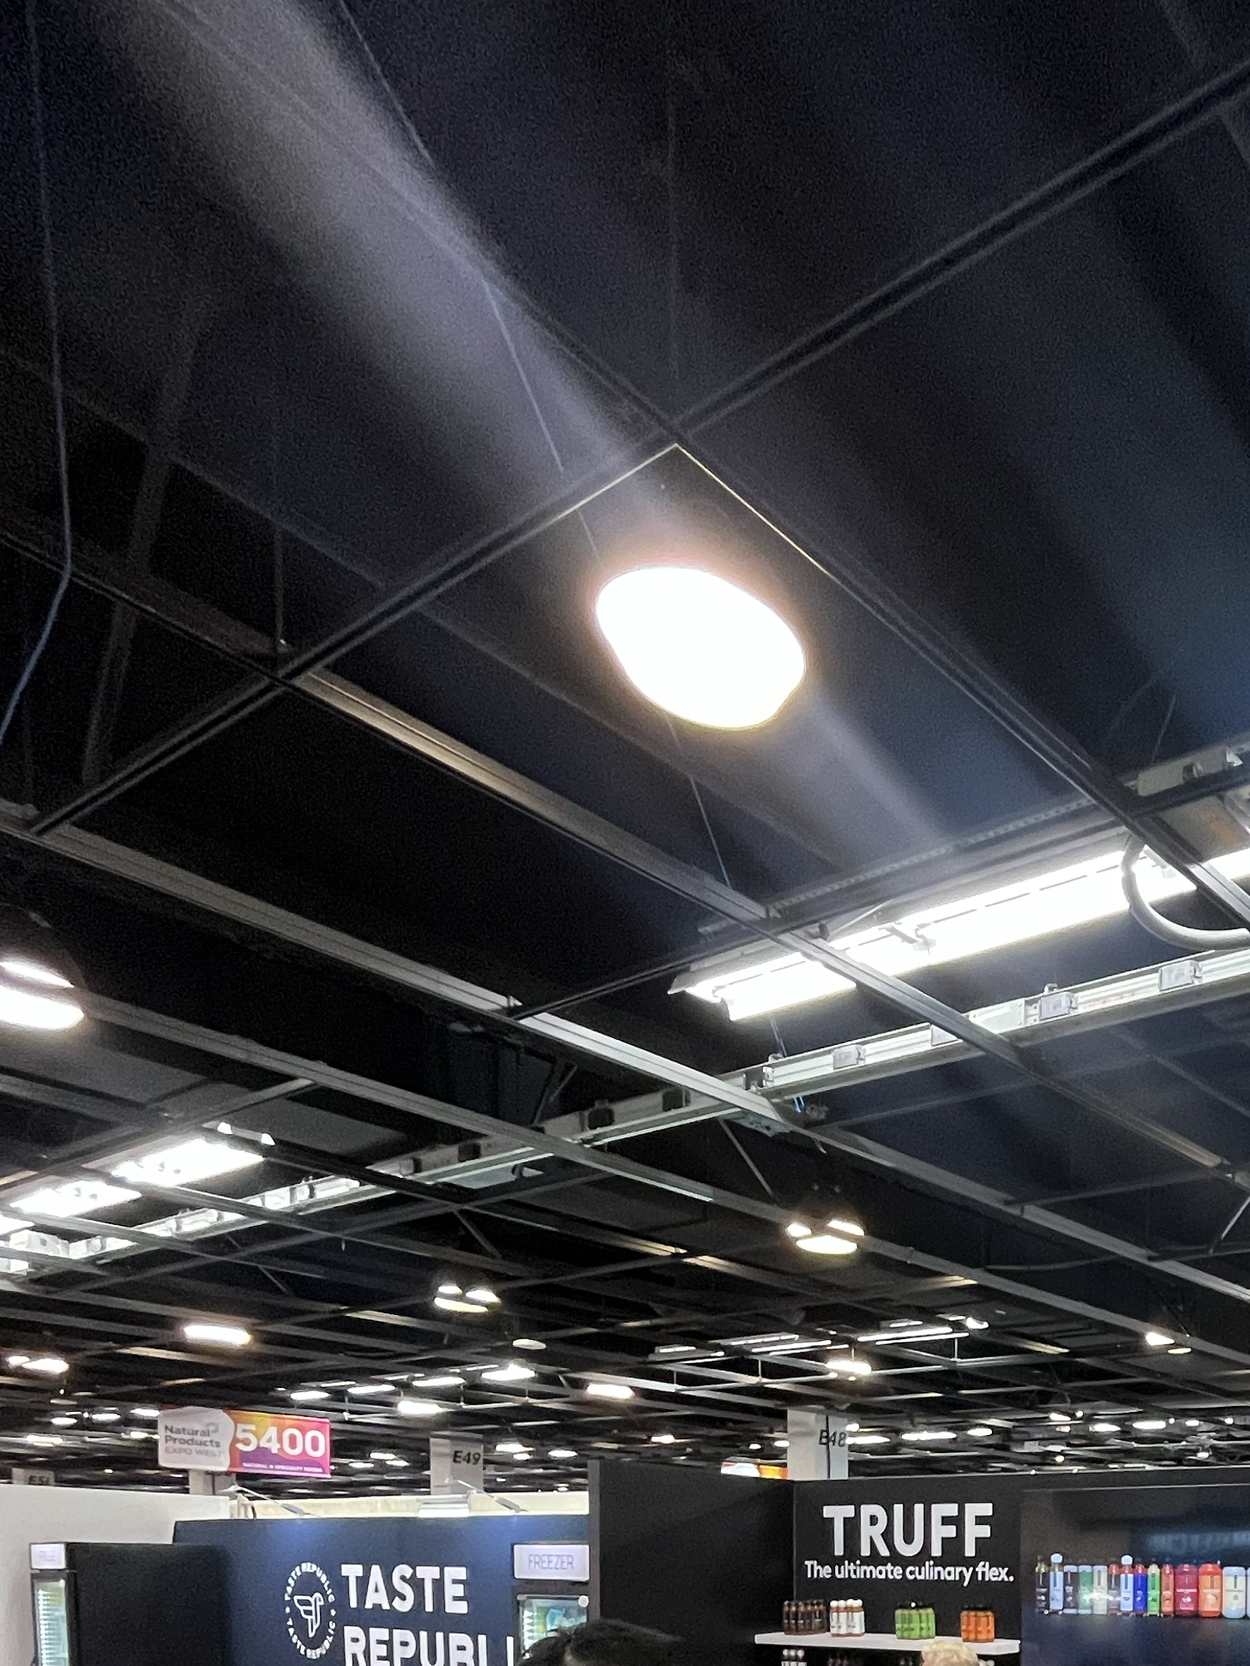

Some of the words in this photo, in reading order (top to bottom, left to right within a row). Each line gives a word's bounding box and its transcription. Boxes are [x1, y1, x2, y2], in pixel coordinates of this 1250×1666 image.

[164, 1424, 211, 1438] Natural
[164, 1434, 221, 1448] Products
[235, 1423, 326, 1458] 5400
[452, 1450, 482, 1465] E49
[822, 1502, 994, 1558] TRUFF
[528, 1553, 575, 1570] FREEZER
[804, 1559, 832, 1579] The
[834, 1559, 904, 1580] ultimate
[905, 1560, 974, 1588] culinary
[975, 1561, 1015, 1583] flex.
[340, 1563, 469, 1614] TASTE
